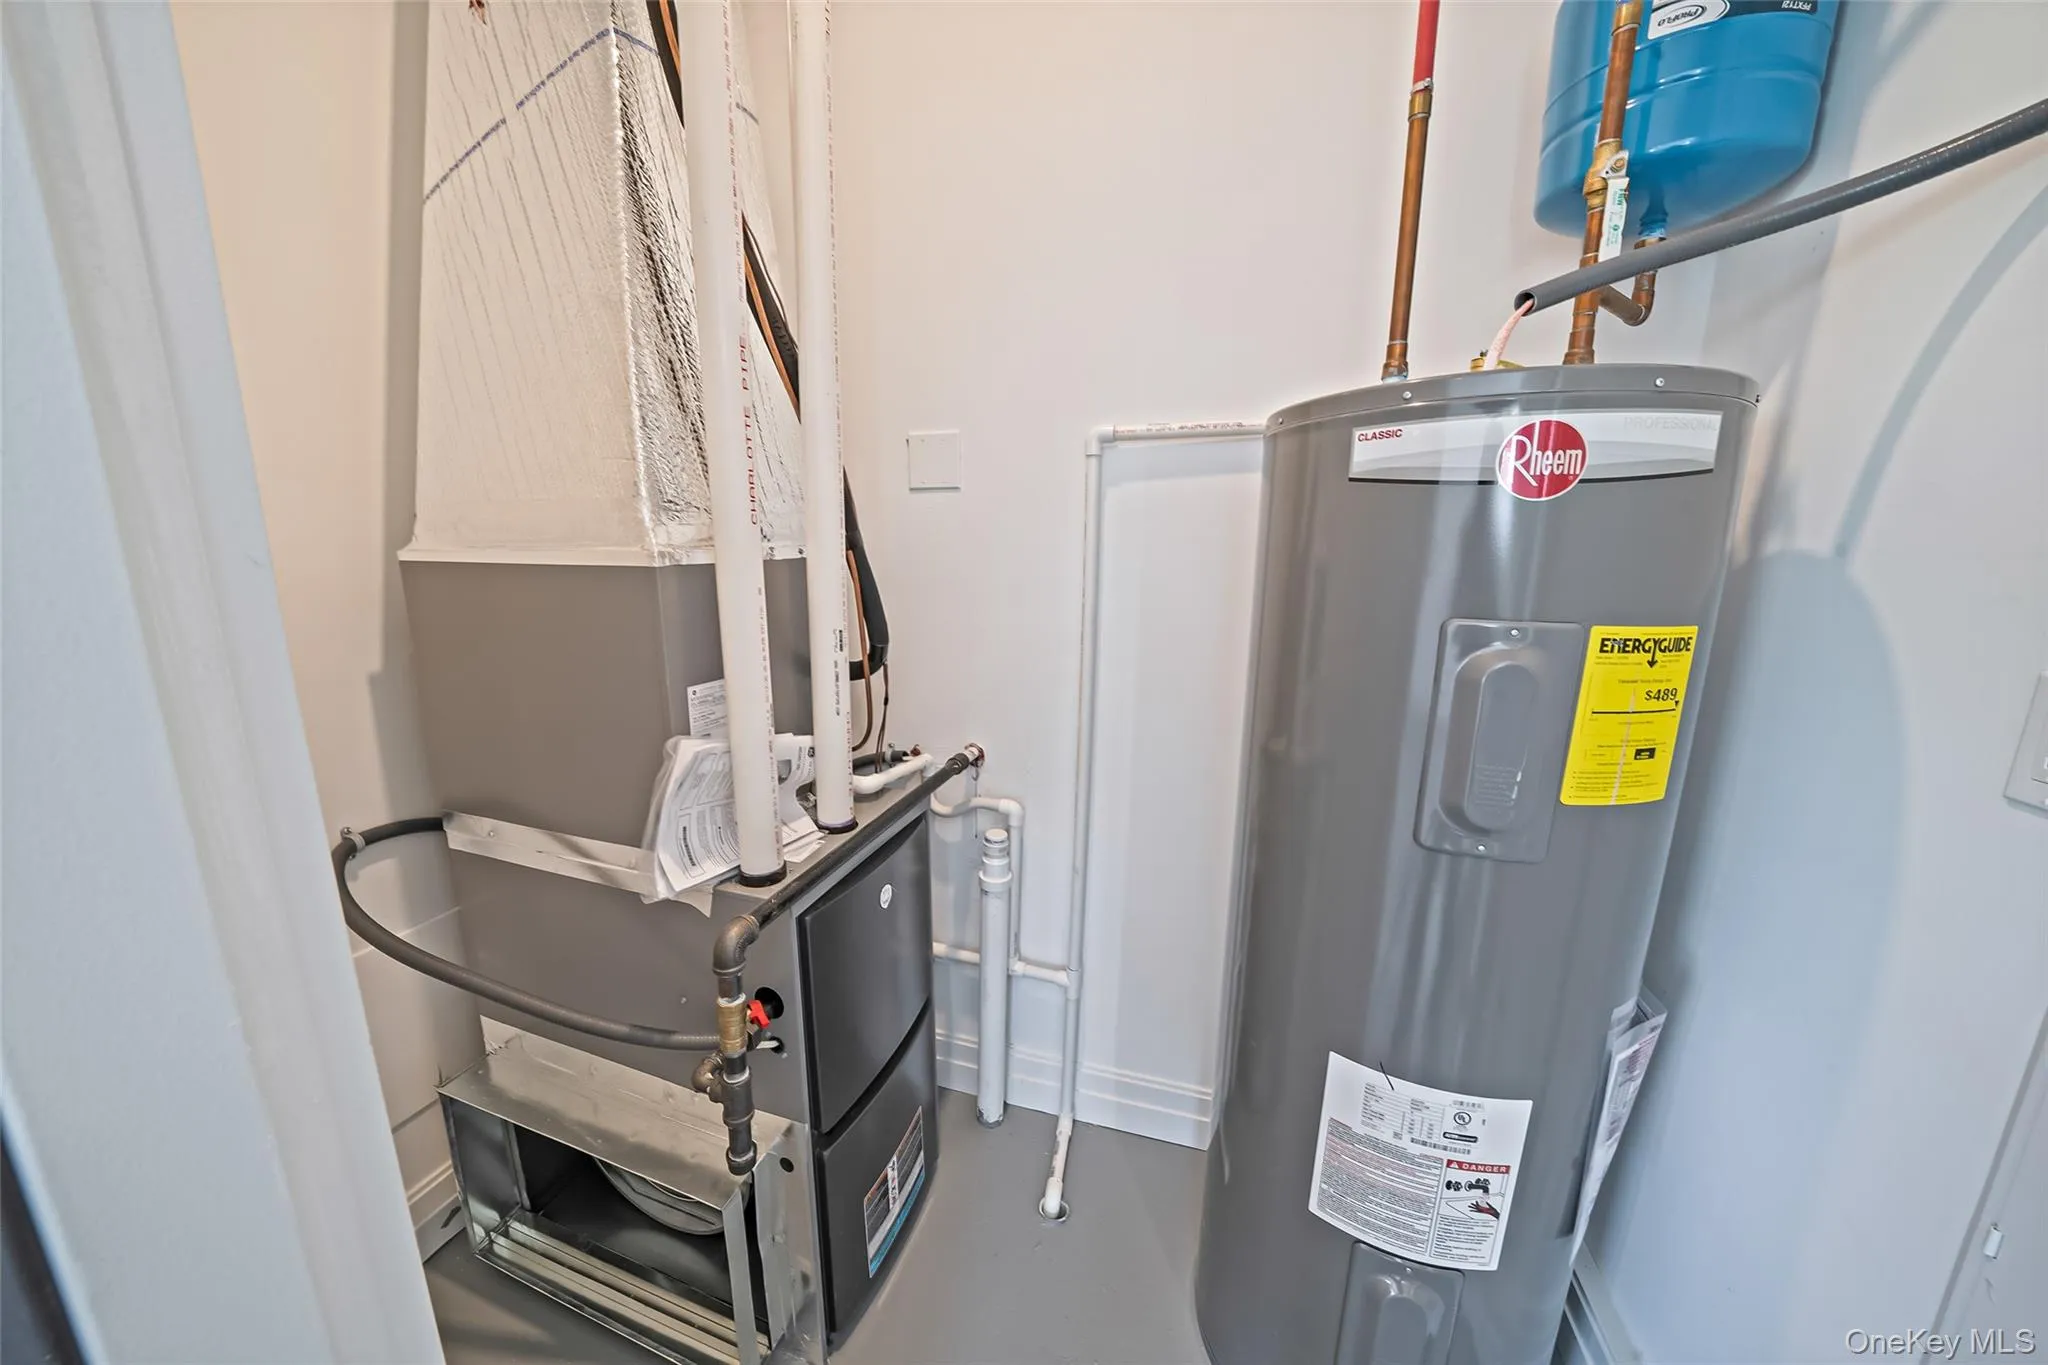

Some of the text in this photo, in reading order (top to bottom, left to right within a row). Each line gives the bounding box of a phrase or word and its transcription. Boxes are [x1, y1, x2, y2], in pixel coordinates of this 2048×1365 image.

[1657, 8, 1699, 27] PROFLO
[740, 335, 758, 526] CHARLOTTE PIPE
[1623, 416, 1718, 431] PROFESSIONAL
[1357, 428, 1403, 443] CLASSIC
[1510, 421, 1582, 487] Rheem
[1644, 687, 1678, 702] $489
[1461, 1163, 1507, 1173] DANGER
